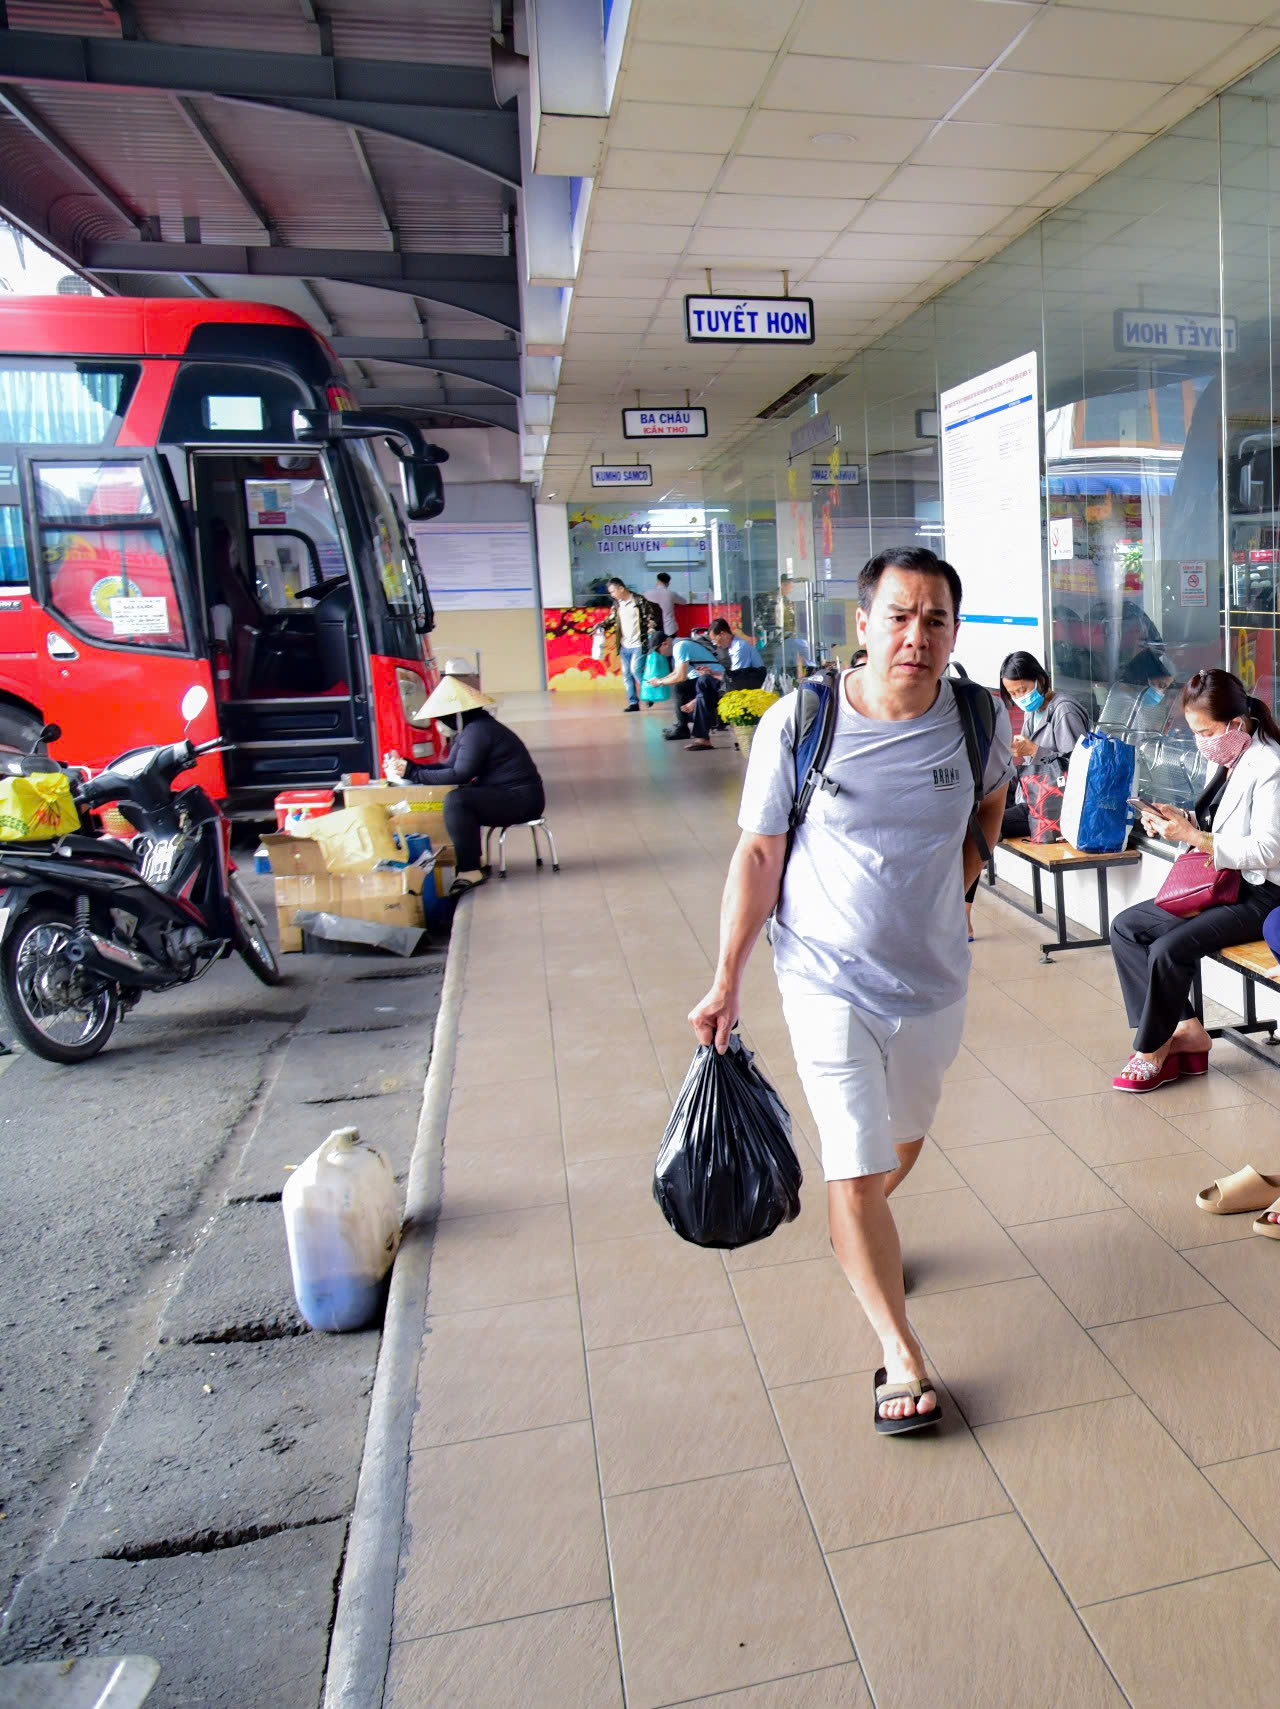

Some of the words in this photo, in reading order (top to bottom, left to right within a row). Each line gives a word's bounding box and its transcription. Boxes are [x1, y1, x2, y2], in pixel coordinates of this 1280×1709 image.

[693, 303, 758, 333] TUYẾT
[767, 312, 807, 334] HON
[640, 413, 656, 424] BA
[660, 411, 690, 424] CHÂU
